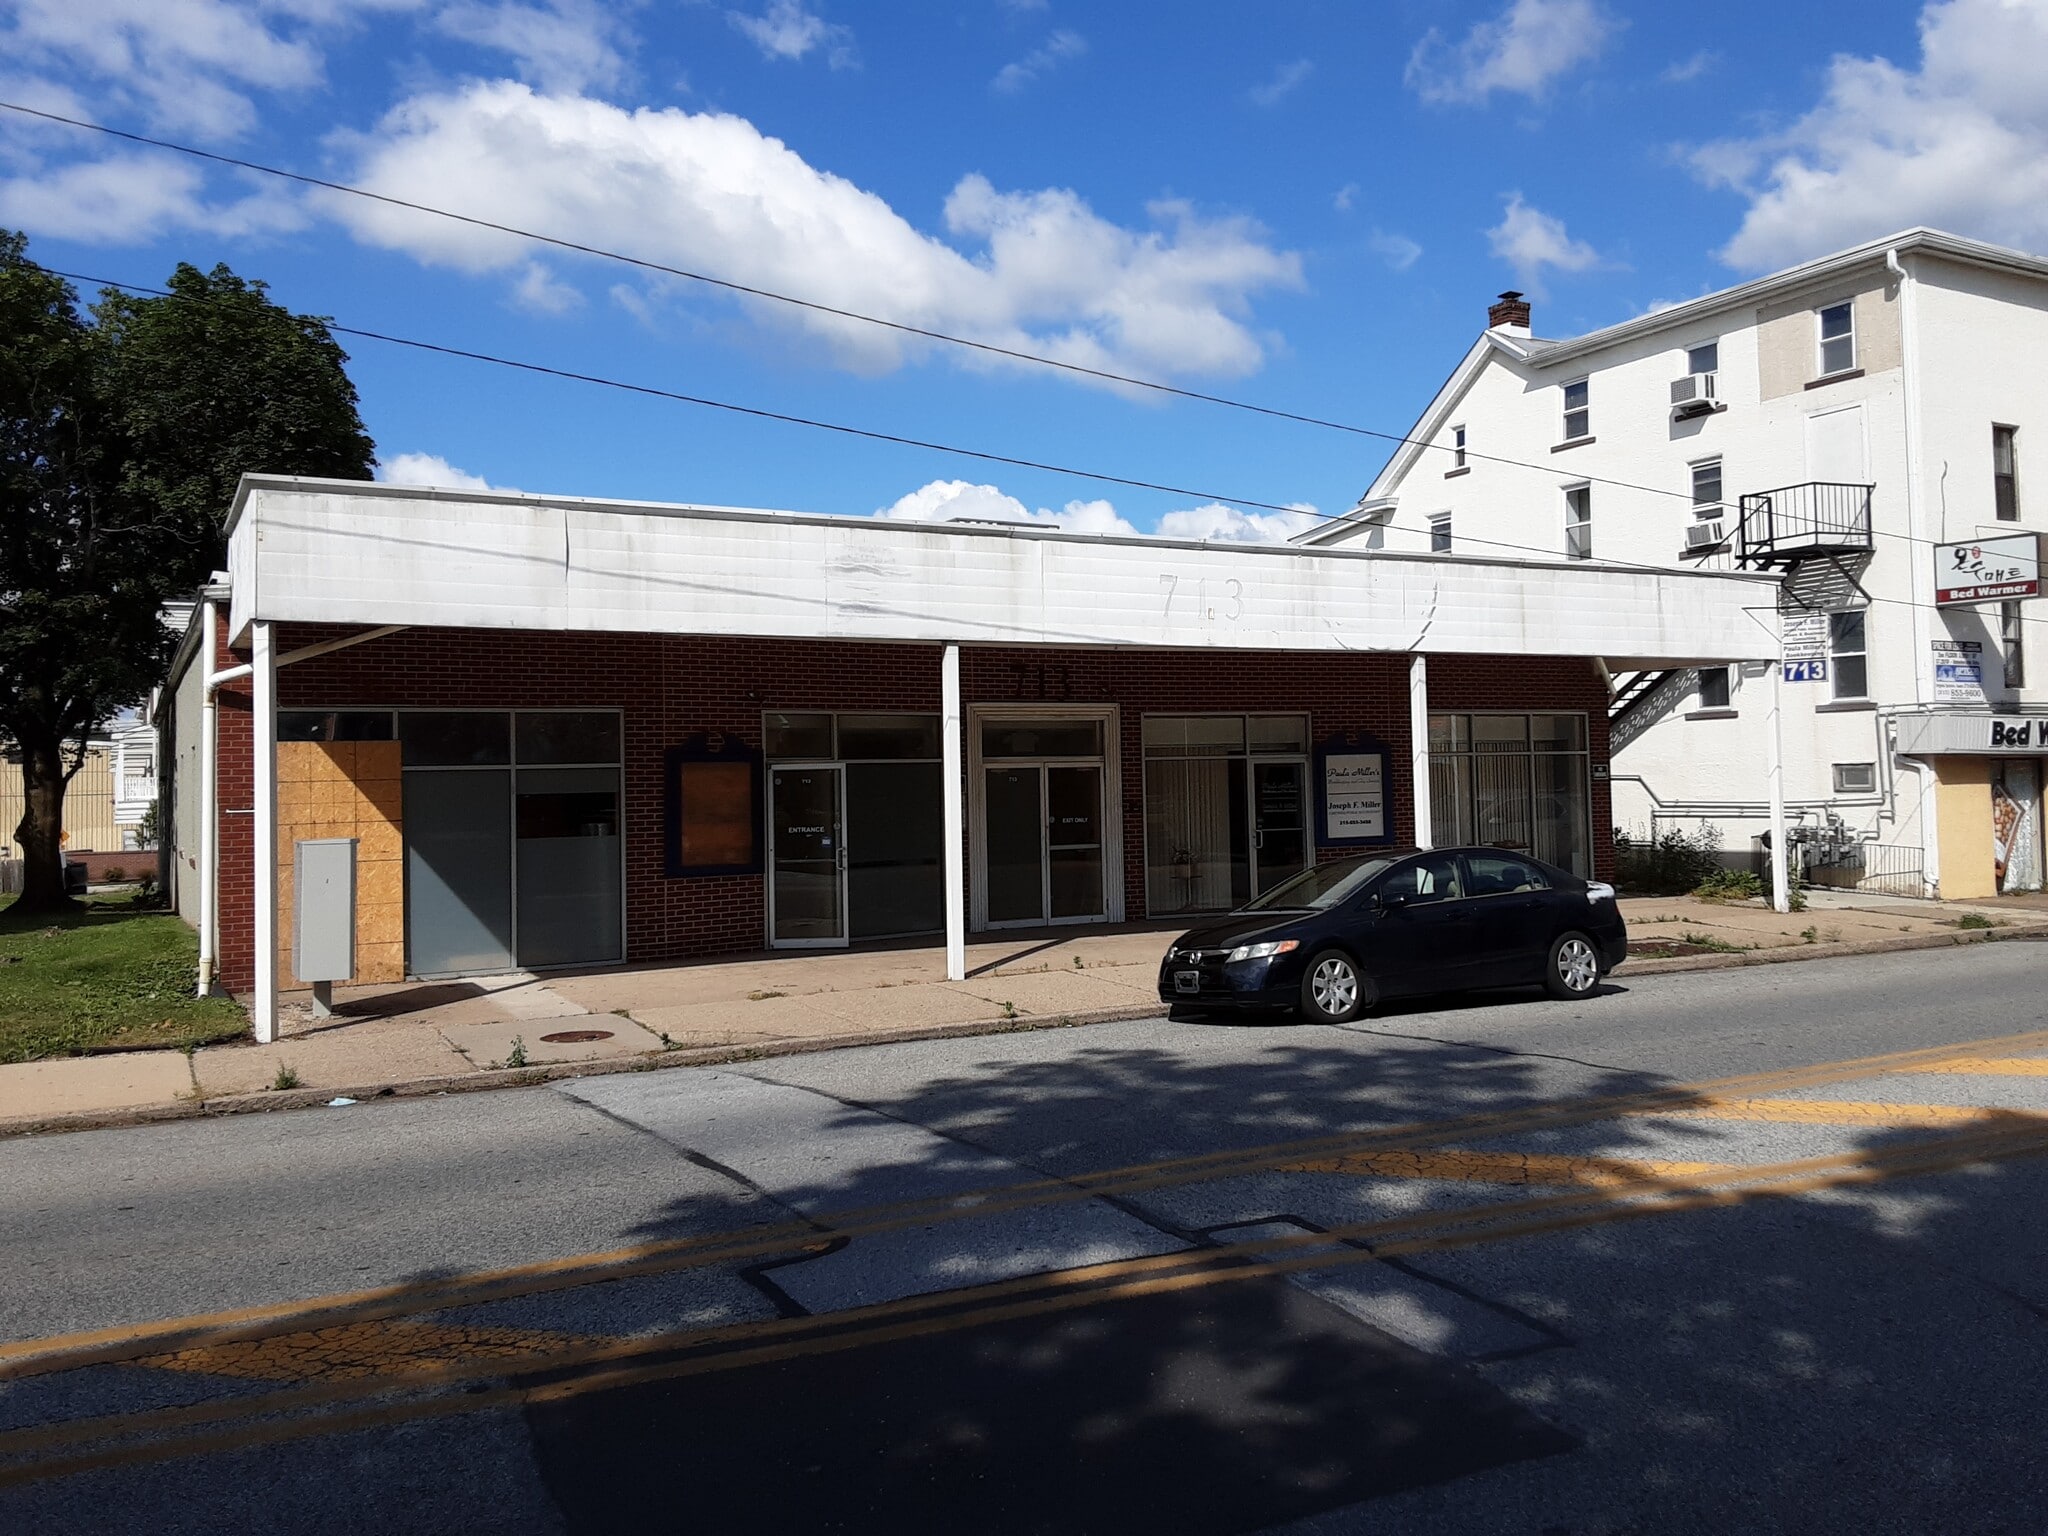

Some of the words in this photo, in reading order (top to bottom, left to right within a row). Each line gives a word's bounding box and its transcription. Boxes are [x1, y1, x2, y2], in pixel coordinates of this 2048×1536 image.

[1160, 574, 1243, 621] 713
[1950, 589, 1974, 599] Bed
[1978, 584, 2028, 597] Warmer
[1786, 662, 1824, 680] 713
[1010, 663, 1071, 700] 713
[1991, 720, 2031, 747] Bed
[1327, 768, 1350, 777] Paula
[1352, 767, 1380, 776] Miller's
[1328, 802, 1351, 810] Joseph
